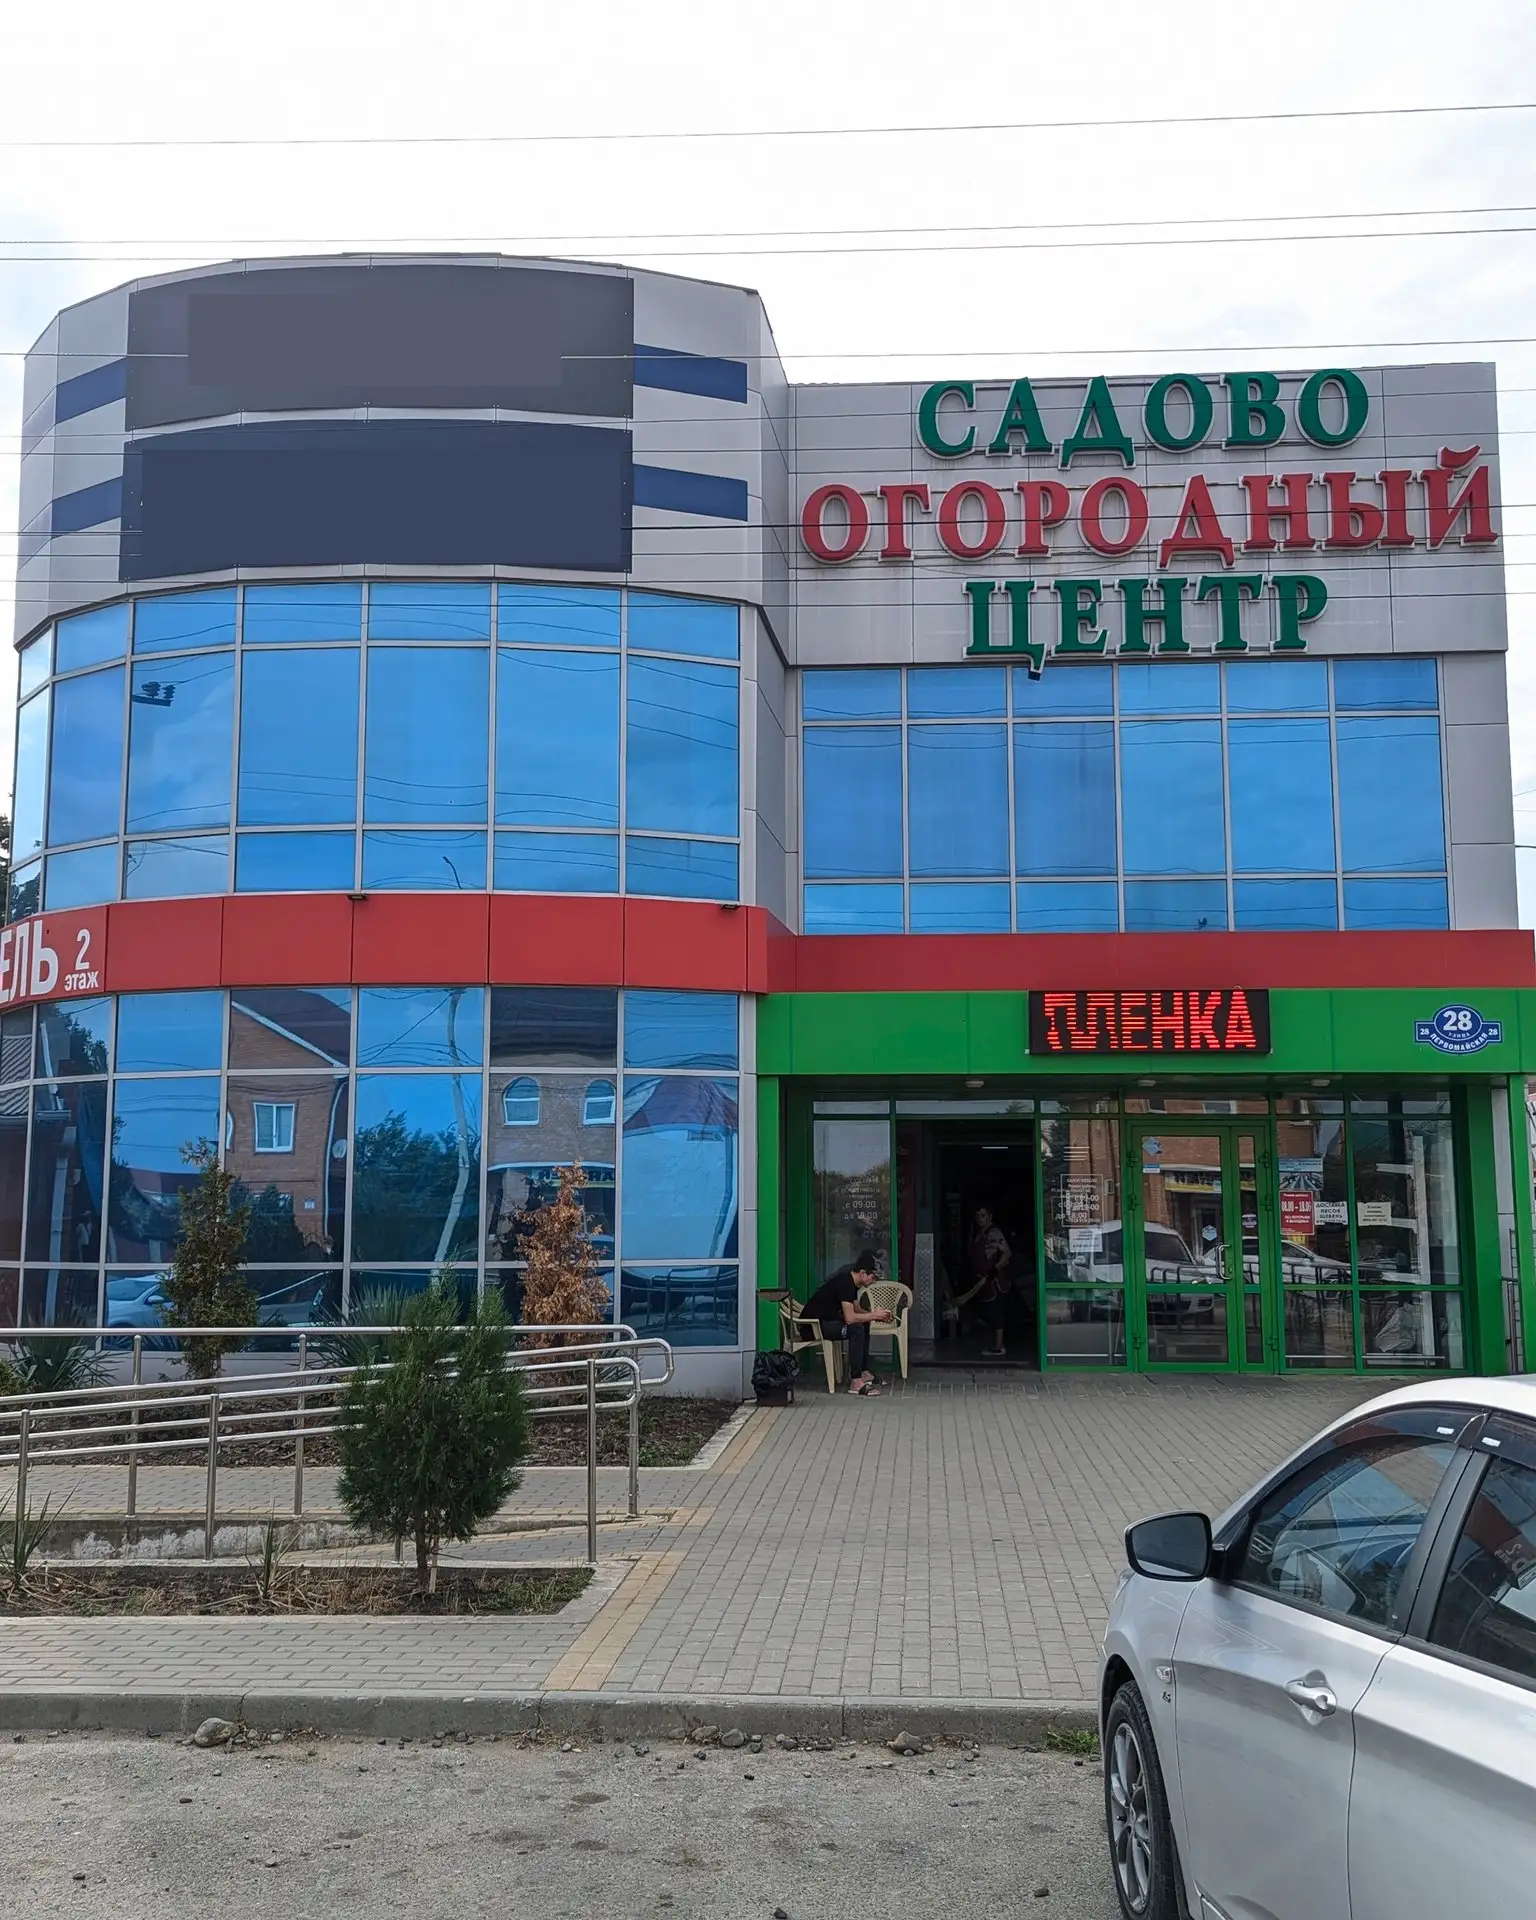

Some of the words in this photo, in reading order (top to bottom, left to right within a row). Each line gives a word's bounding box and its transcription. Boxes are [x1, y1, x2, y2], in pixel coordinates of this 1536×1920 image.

[916, 369, 1371, 469] САДОВО
[800, 445, 1499, 571] ОГОРОДНЫЙ
[962, 574, 1328, 674] ЦЕНТР
[75, 929, 91, 970] 2
[64, 971, 99, 991] этаж
[1443, 1010, 1472, 1031] 28
[1419, 1028, 1430, 1036] 28
[1430, 1032, 1488, 1051] ПЕРВОМАЙСКАЯ
[1488, 1028, 1499, 1036] 28
